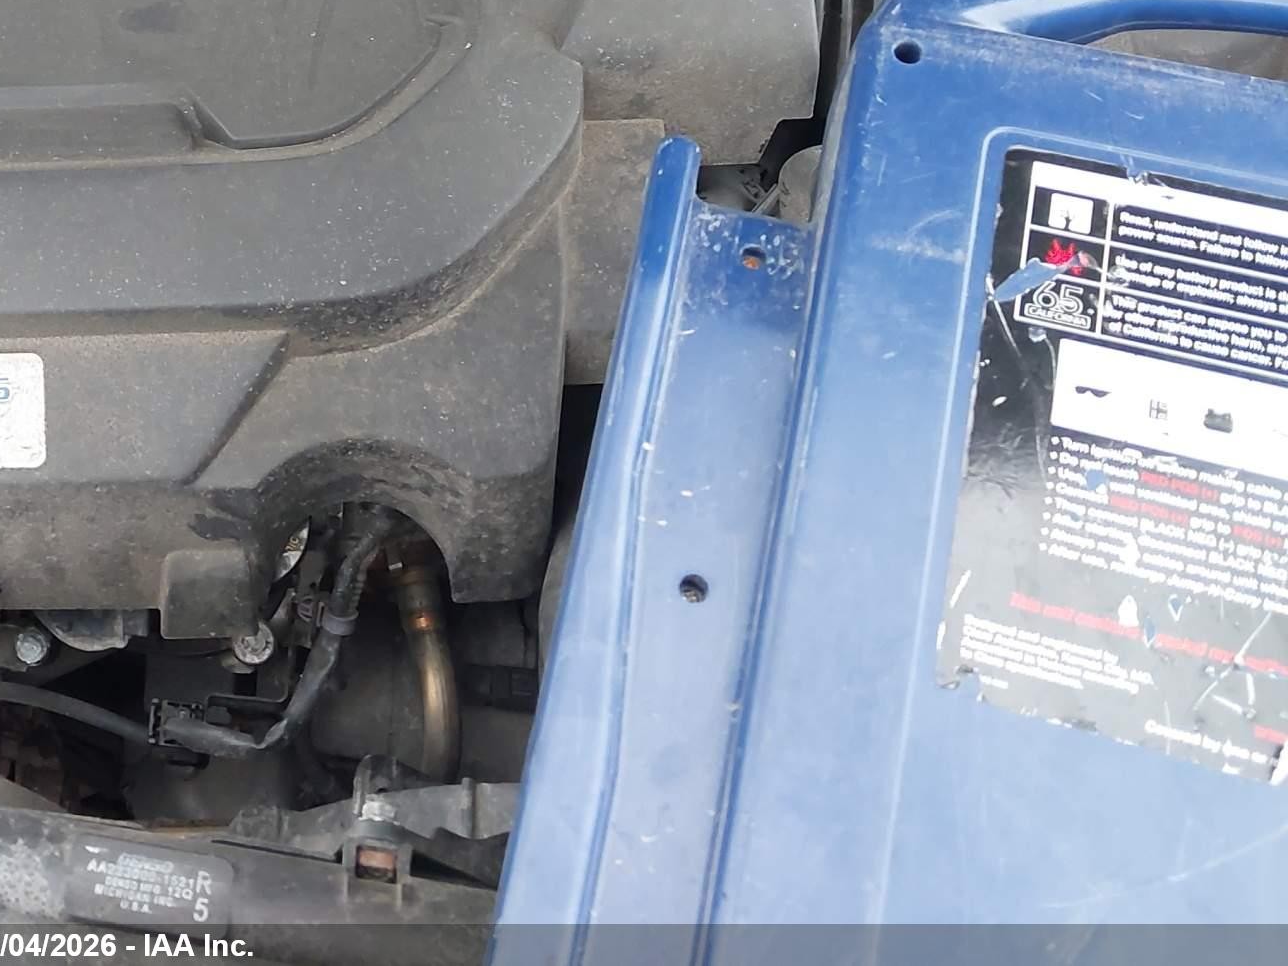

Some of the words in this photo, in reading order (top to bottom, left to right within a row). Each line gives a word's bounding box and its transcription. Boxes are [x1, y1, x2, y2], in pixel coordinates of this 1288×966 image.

[1033, 280, 1084, 314] 65
[195, 870, 213, 895] R
[192, 897, 209, 923] 5
